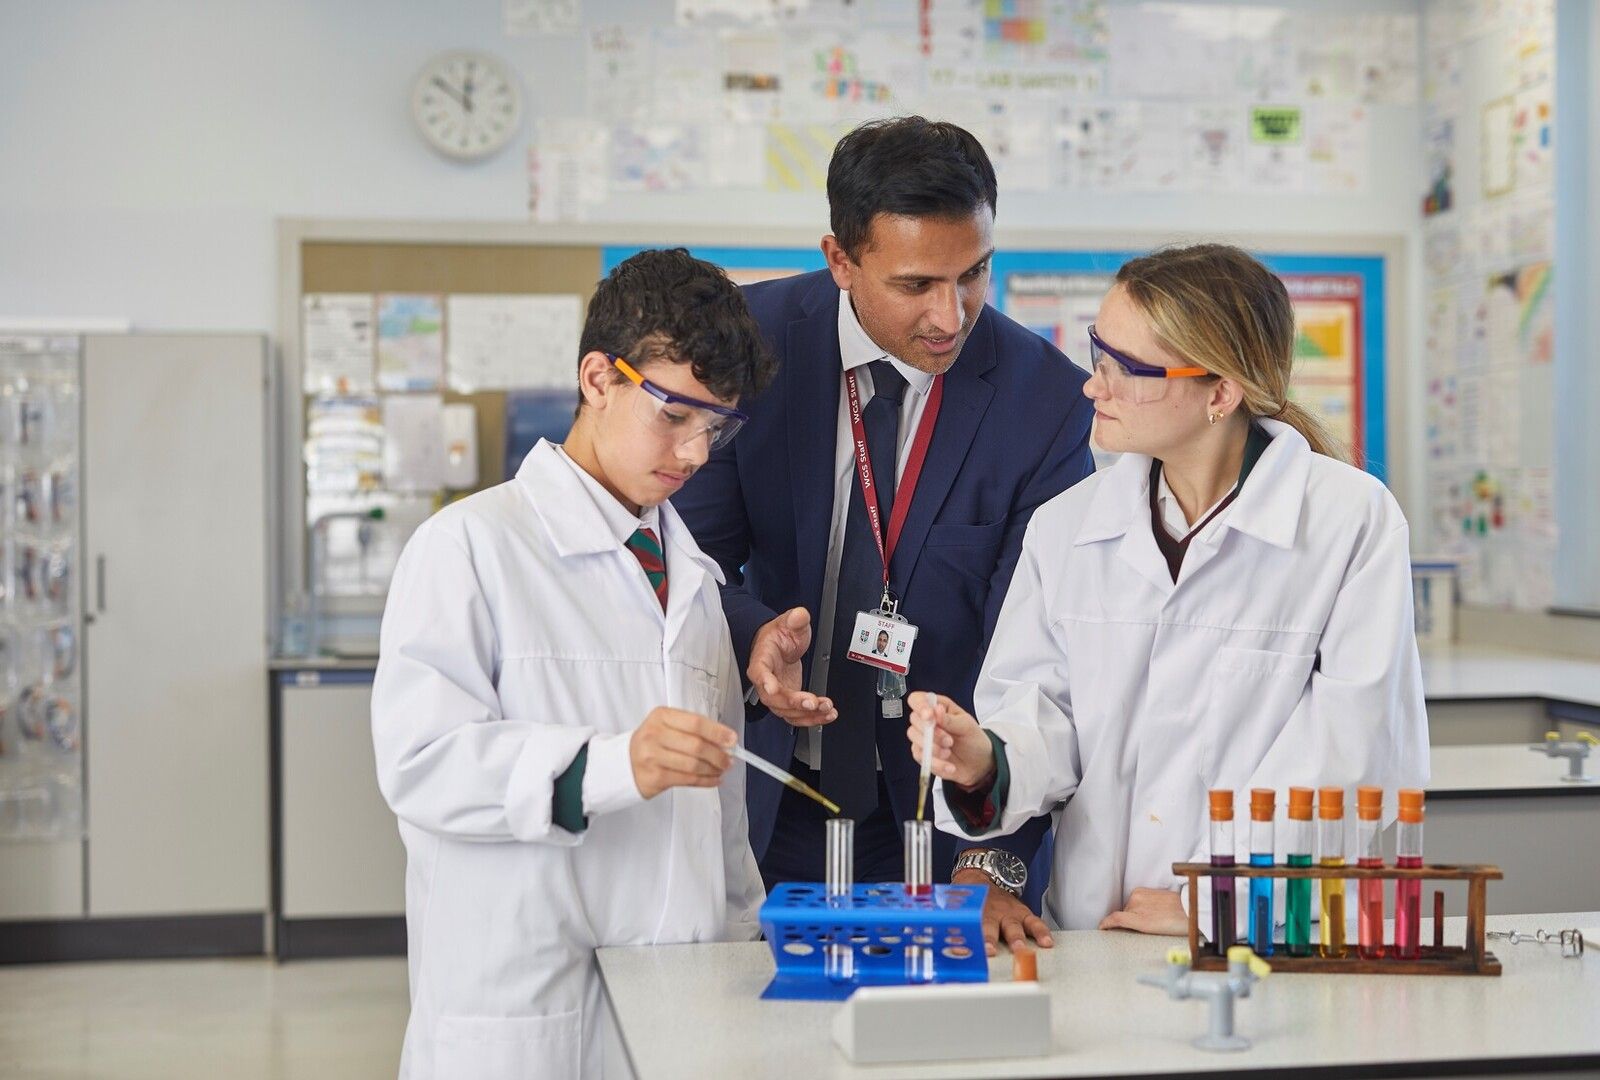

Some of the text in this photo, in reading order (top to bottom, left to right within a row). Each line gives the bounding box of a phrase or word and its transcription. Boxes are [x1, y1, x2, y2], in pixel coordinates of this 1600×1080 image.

[849, 376, 860, 424] WGS Staff
[857, 440, 871, 489] WGS Staff
[870, 506, 879, 528] Staff
[877, 620, 895, 629] STAFF
